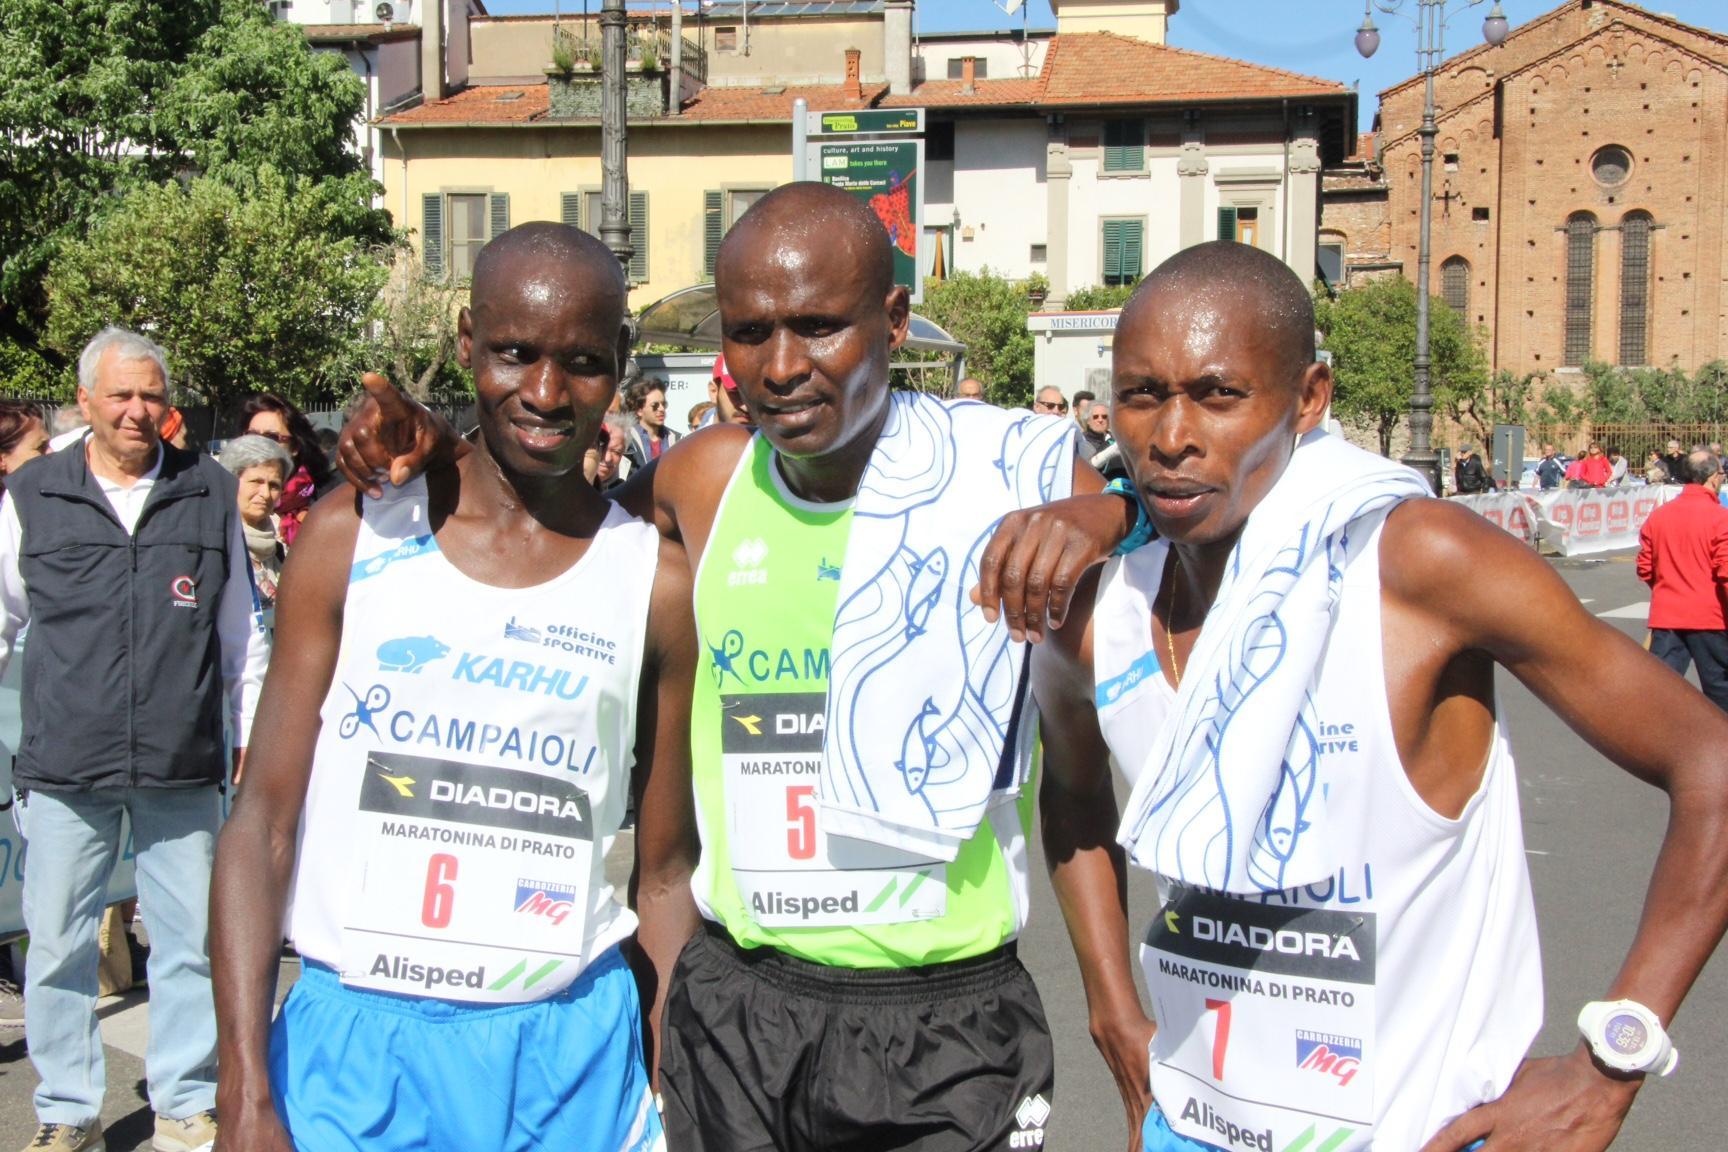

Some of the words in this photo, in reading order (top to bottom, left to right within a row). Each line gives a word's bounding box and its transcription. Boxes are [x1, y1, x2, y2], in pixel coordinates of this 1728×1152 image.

[1050, 317, 1117, 329] MISERICOR
[542, 637, 616, 666] SPORTIVE
[547, 624, 616, 650] officine
[452, 652, 589, 700] KARHU
[749, 648, 830, 681] CAM
[775, 713, 825, 734] DIA
[1319, 721, 1354, 736] ine
[390, 710, 597, 775] CAMPAIOLI
[741, 761, 821, 775] MARATONI
[430, 779, 583, 821] DIADORA
[381, 821, 496, 849] MARATONINA
[500, 836, 517, 852] DI
[521, 839, 575, 860] PRATO
[786, 785, 816, 860] 5
[421, 853, 459, 929] 6
[517, 891, 575, 926] MG
[752, 890, 859, 920] Alisped
[1193, 916, 1361, 961] DIADORA
[369, 954, 485, 989] Alisped
[1159, 958, 1266, 996] MARATONINA
[1269, 982, 1288, 998] DI
[1292, 985, 1355, 1008] PRATO
[1205, 998, 1231, 1081] 7
[1296, 1029, 1361, 1049] CARROZZERIA
[1300, 1044, 1360, 1087] MG
[1180, 1096, 1273, 1152] Alisped
